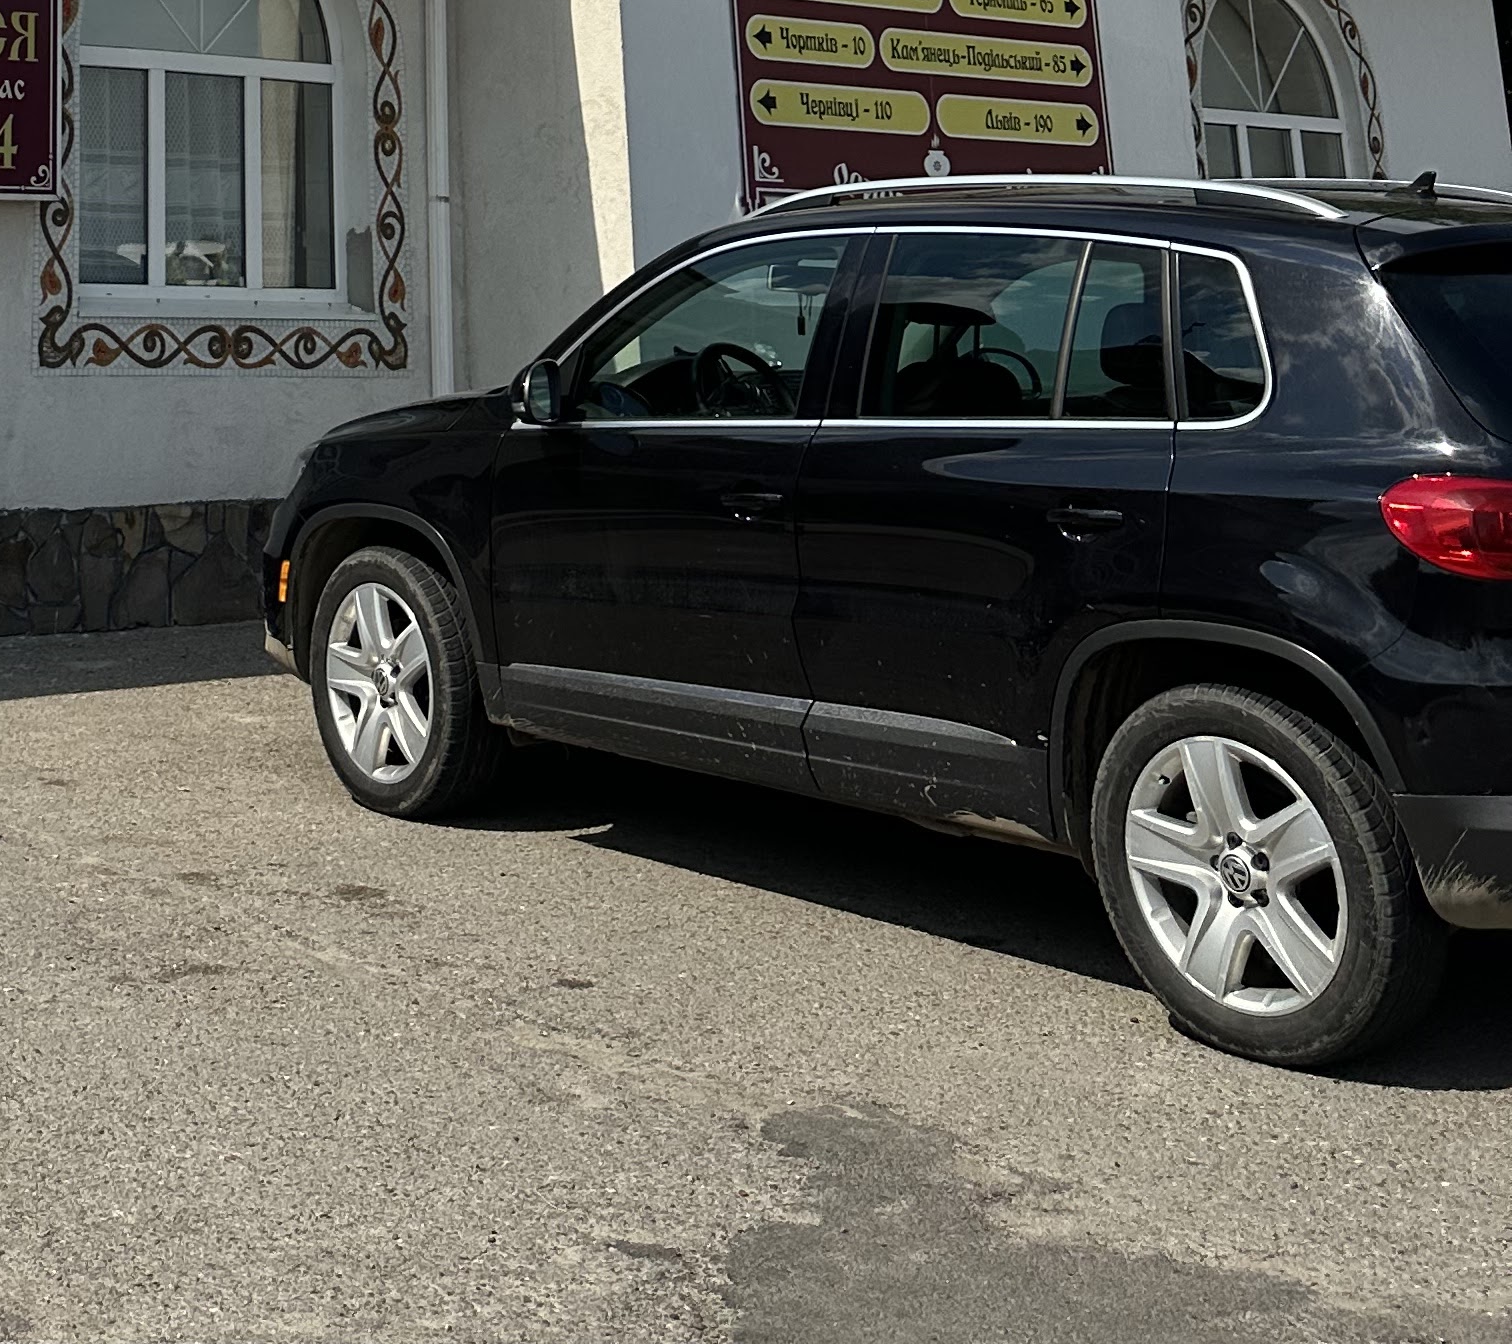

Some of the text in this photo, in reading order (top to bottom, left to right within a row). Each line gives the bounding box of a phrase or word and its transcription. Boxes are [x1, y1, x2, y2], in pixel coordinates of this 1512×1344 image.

[779, 26, 838, 55] Чортків
[852, 36, 866, 55] 10
[1052, 54, 1067, 74] 85
[799, 92, 859, 121] Чернівці
[874, 99, 893, 120] 110
[985, 108, 1022, 131] Львів
[1034, 113, 1053, 133] 190
